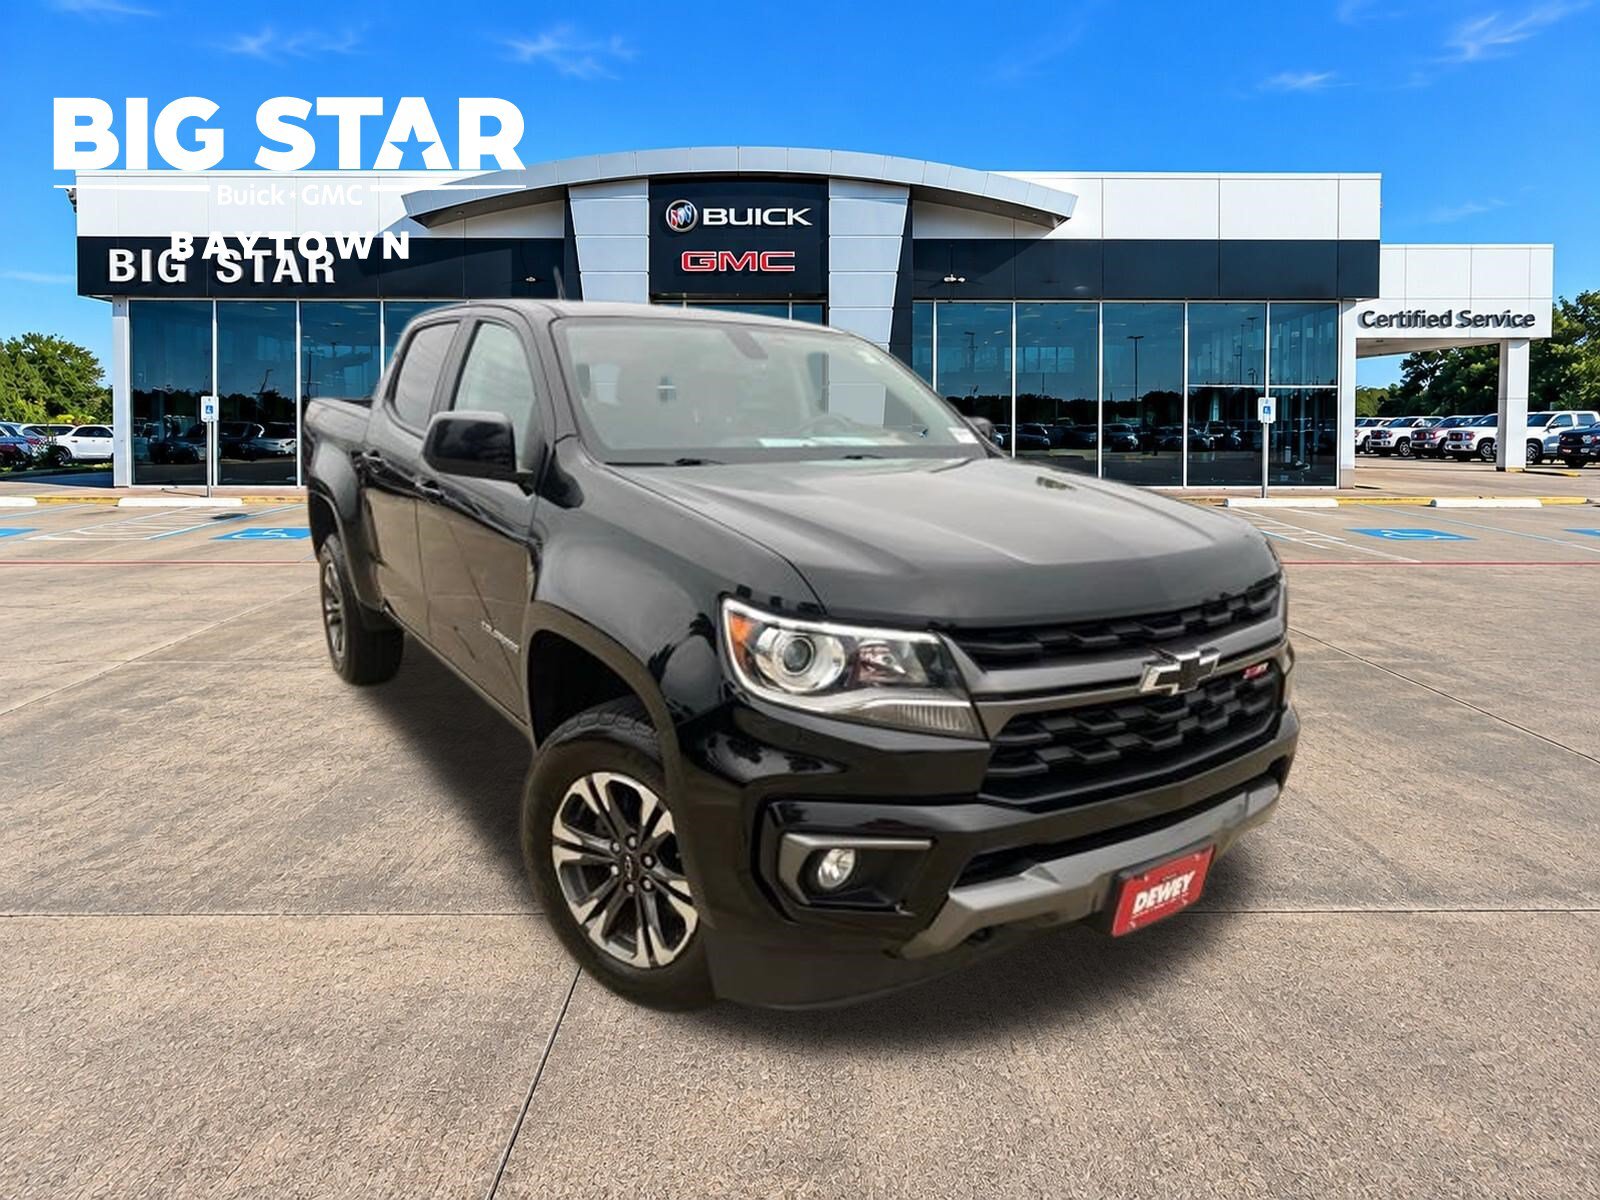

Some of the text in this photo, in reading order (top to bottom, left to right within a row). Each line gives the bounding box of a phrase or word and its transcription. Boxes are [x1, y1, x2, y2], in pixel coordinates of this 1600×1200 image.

[702, 207, 813, 226] BUICK
[108, 248, 336, 284] BIG STAR
[681, 251, 796, 272] GMC
[1360, 309, 1537, 329] Certified Service
[1132, 869, 1197, 915] DEWEY
